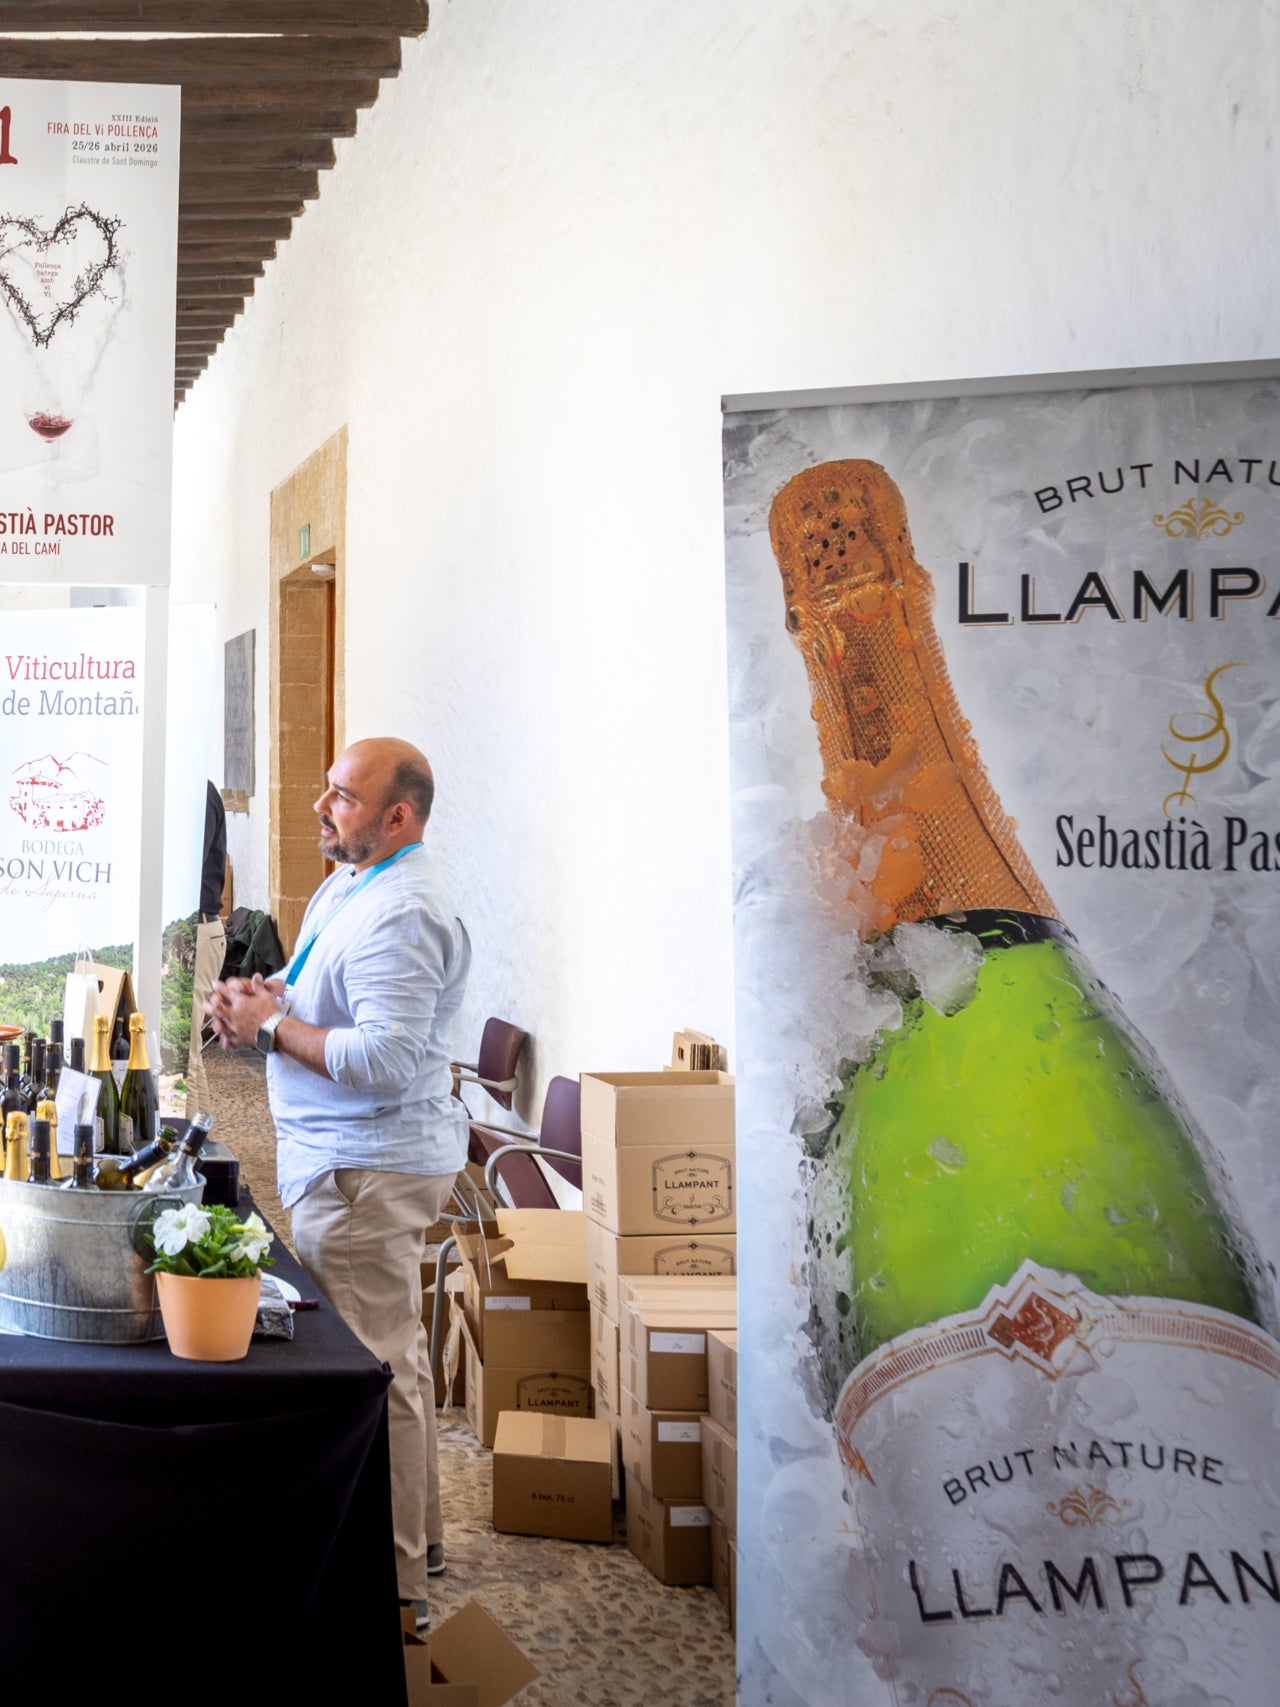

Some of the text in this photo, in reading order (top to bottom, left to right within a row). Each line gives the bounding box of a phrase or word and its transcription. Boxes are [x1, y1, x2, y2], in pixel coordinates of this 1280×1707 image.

[111, 114, 159, 123] XXIII Edició
[47, 122, 158, 140] FIRA DEL Vi POLLENÇA
[72, 140, 158, 153] 25/26 abril 2026
[72, 155, 158, 168] Claustre de Sant Domingo
[1033, 463, 1153, 513] BRUT
[43, 513, 114, 536] PASTOR
[11, 541, 31, 555] DEL
[34, 539, 62, 555] CAMÍ
[958, 562, 1280, 625] LLAMP
[5, 653, 136, 680] Viticultura
[2, 690, 139, 716] de Montañ
[22, 839, 84, 856] BODEGA
[1055, 814, 1213, 870] Sebastià
[53, 860, 112, 883] VICH
[664, 1180, 720, 1189] LLAMPANT
[527, 1398, 580, 1408] LLAMPANT
[943, 1440, 1224, 1506] BRUT NATURE
[908, 1550, 1280, 1624] LLAMPAN
